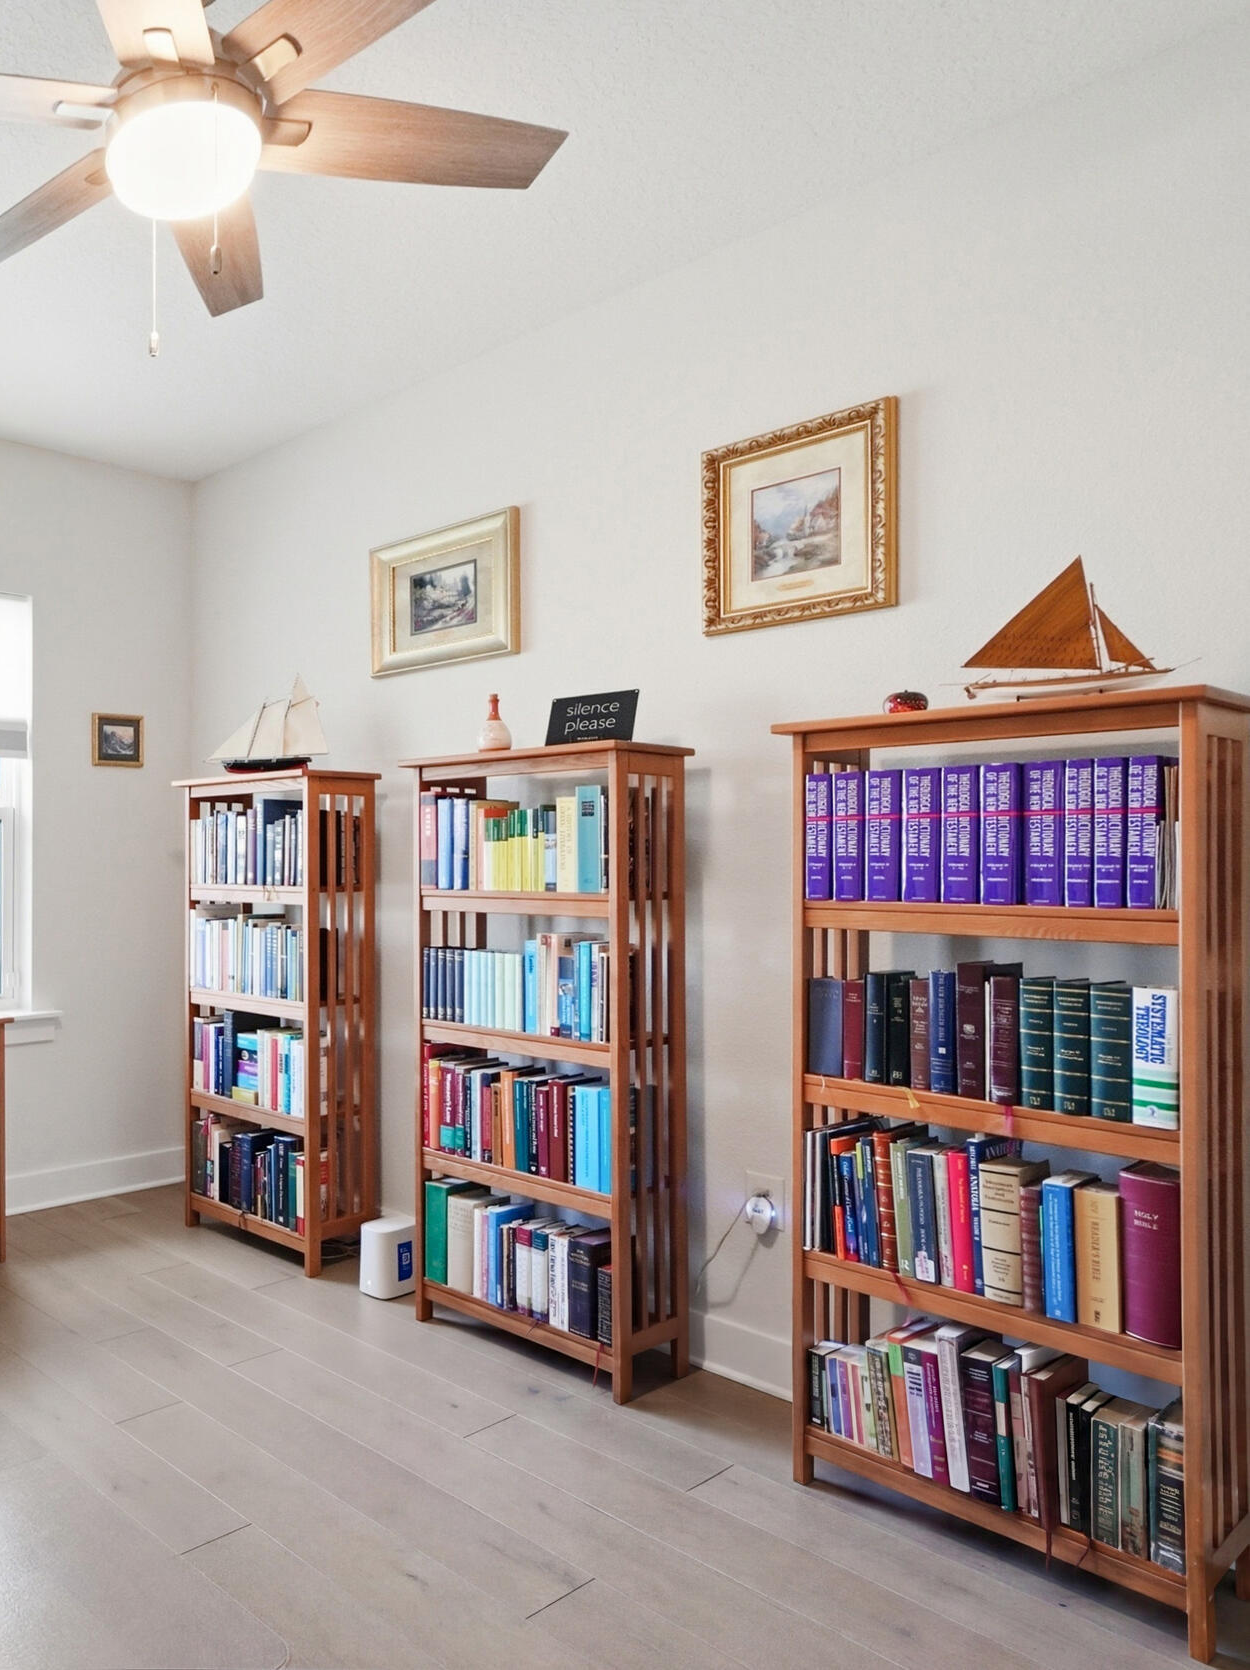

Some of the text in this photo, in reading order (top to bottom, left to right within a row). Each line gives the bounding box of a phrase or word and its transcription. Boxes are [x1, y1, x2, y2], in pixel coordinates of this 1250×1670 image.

[564, 717, 616, 735] please
[566, 702, 620, 716] silence
[837, 780, 846, 856] OF THE NEW TESTAMENT
[870, 778, 879, 856] OF THE NEW TESTAMENT
[909, 776, 918, 856] OF THE NEW TESTAMENT
[947, 774, 958, 856] OF THE NEW TESTAMENT
[959, 817, 970, 856] DICTIONARY
[986, 772, 997, 856] OF THE NEW TESTAMENT
[998, 816, 1010, 856] DICTIONARY
[1030, 770, 1041, 856] OF THE NEW TESTAMENT
[1042, 815, 1054, 856] DICTIONARY
[1067, 768, 1077, 856] OF THE NEW TESTAMENT
[1078, 814, 1091, 856] DICTIONARY
[1096, 767, 1107, 856] OF THE NEW TESTAMENT
[1109, 814, 1122, 857] DICTIONARY
[1129, 765, 1141, 856] OF THE NEW TESTAMENT
[1143, 813, 1157, 857] DICTIONARY
[1135, 1006, 1150, 1062] THEOLOGY
[1150, 994, 1166, 1064] SYSTEMATIC
[970, 1174, 979, 1211] ANATOLIA
[1134, 1209, 1158, 1220] HOLY
